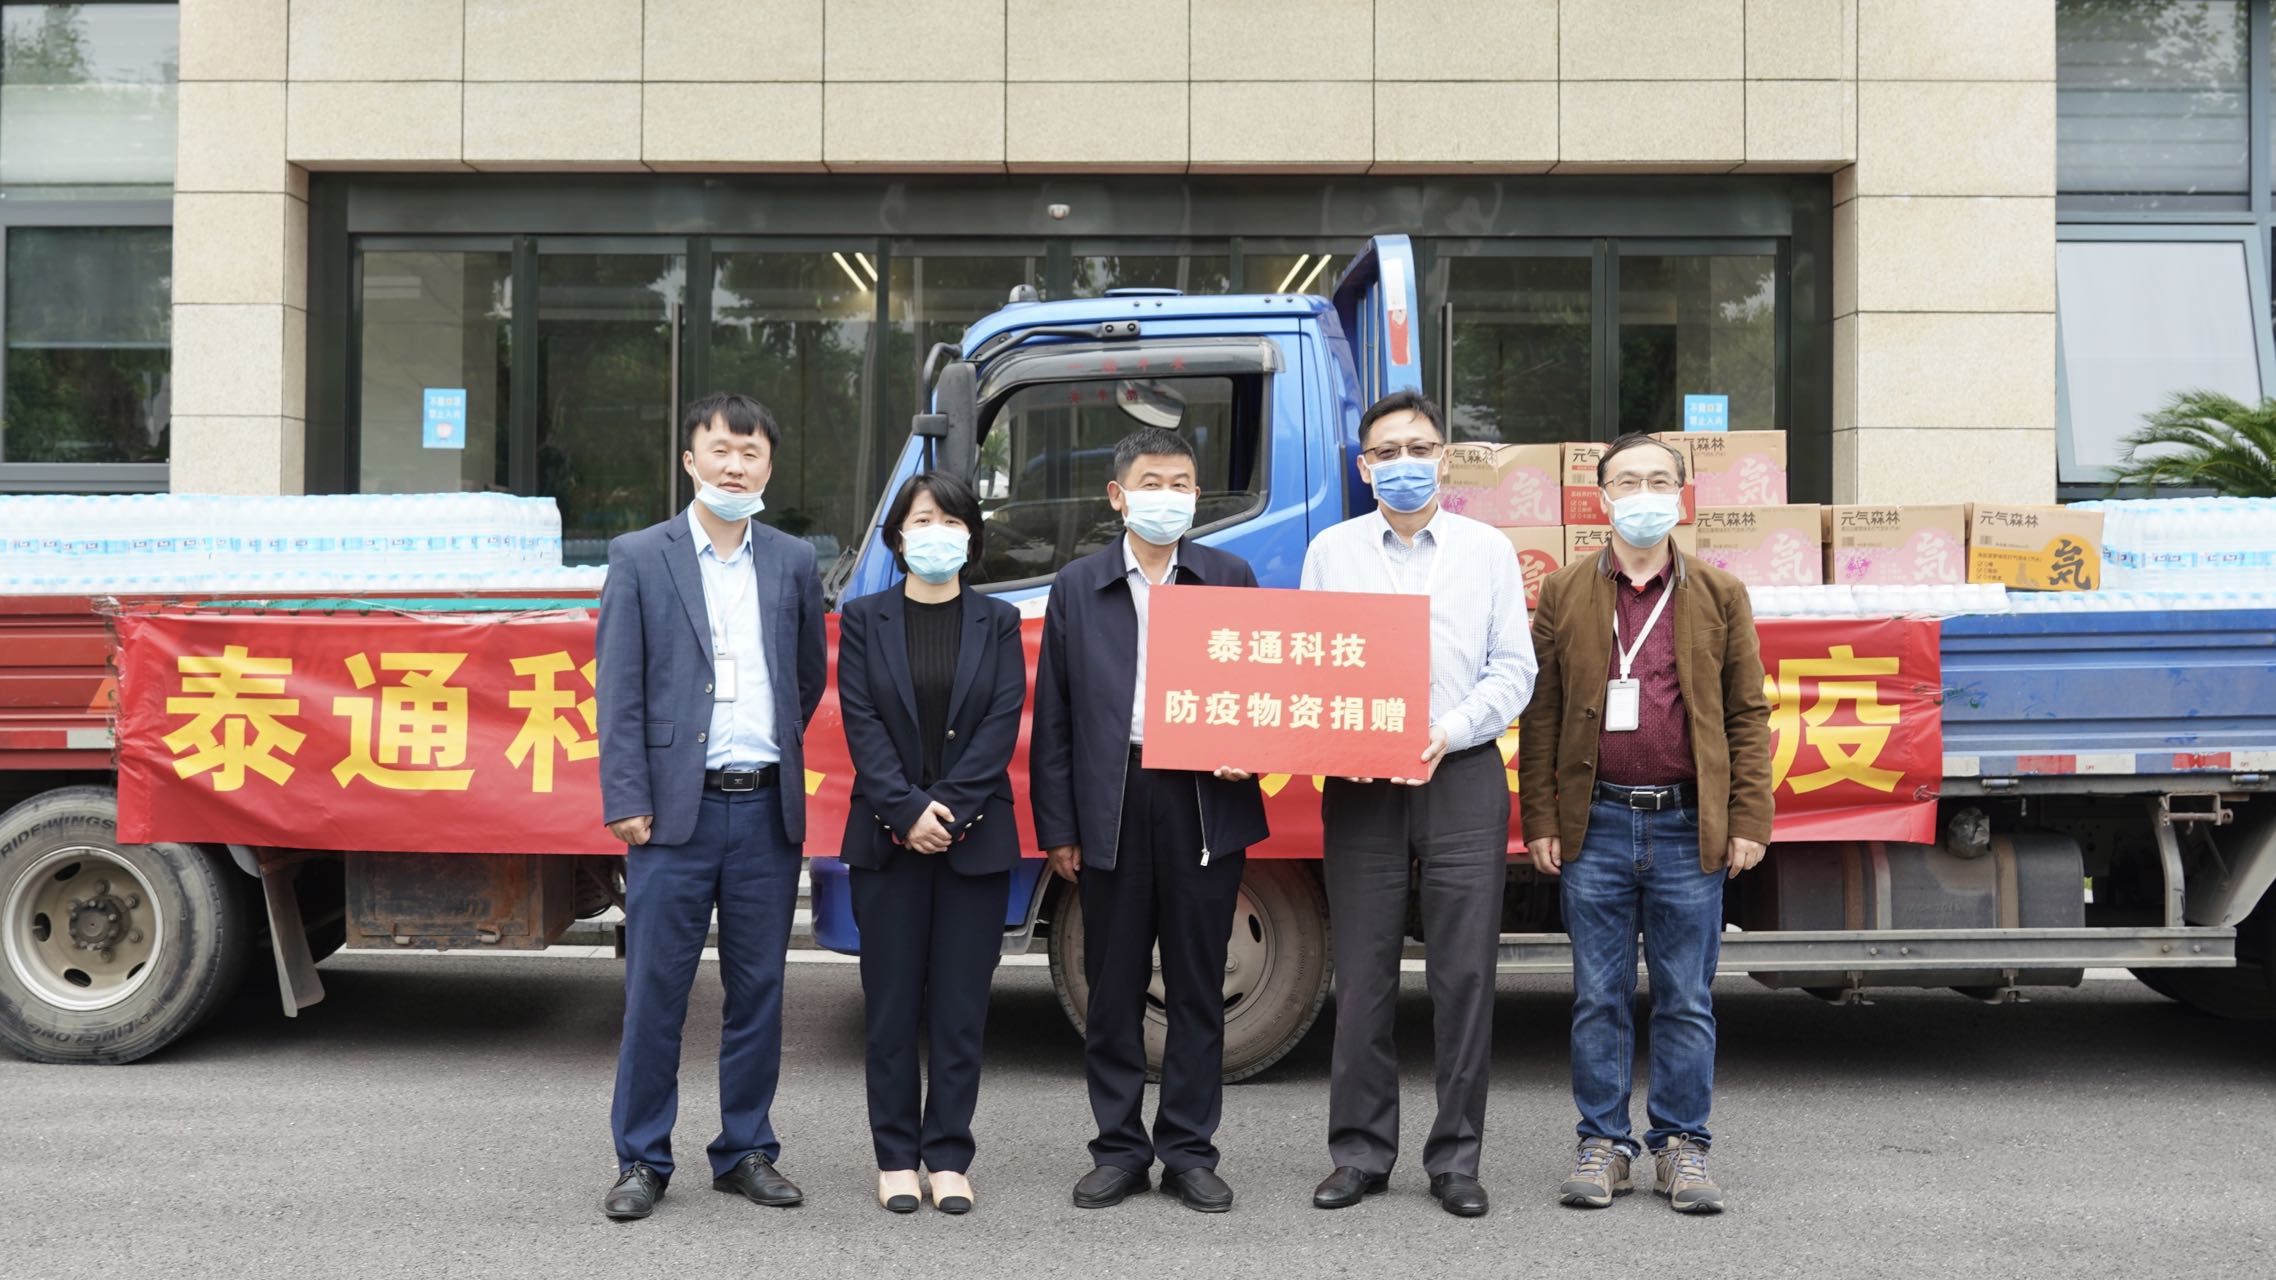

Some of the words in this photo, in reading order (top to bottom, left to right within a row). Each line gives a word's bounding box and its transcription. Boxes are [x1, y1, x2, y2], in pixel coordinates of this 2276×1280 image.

[1697, 511, 1758, 528] 元气森林
[1841, 509, 1901, 526] 元气森林
[1979, 510, 2039, 528] 元气森林
[1207, 628, 1367, 668] 泰通科技
[1165, 689, 1407, 733] 防疫物资捐赠
[1763, 645, 1906, 795] 疫
